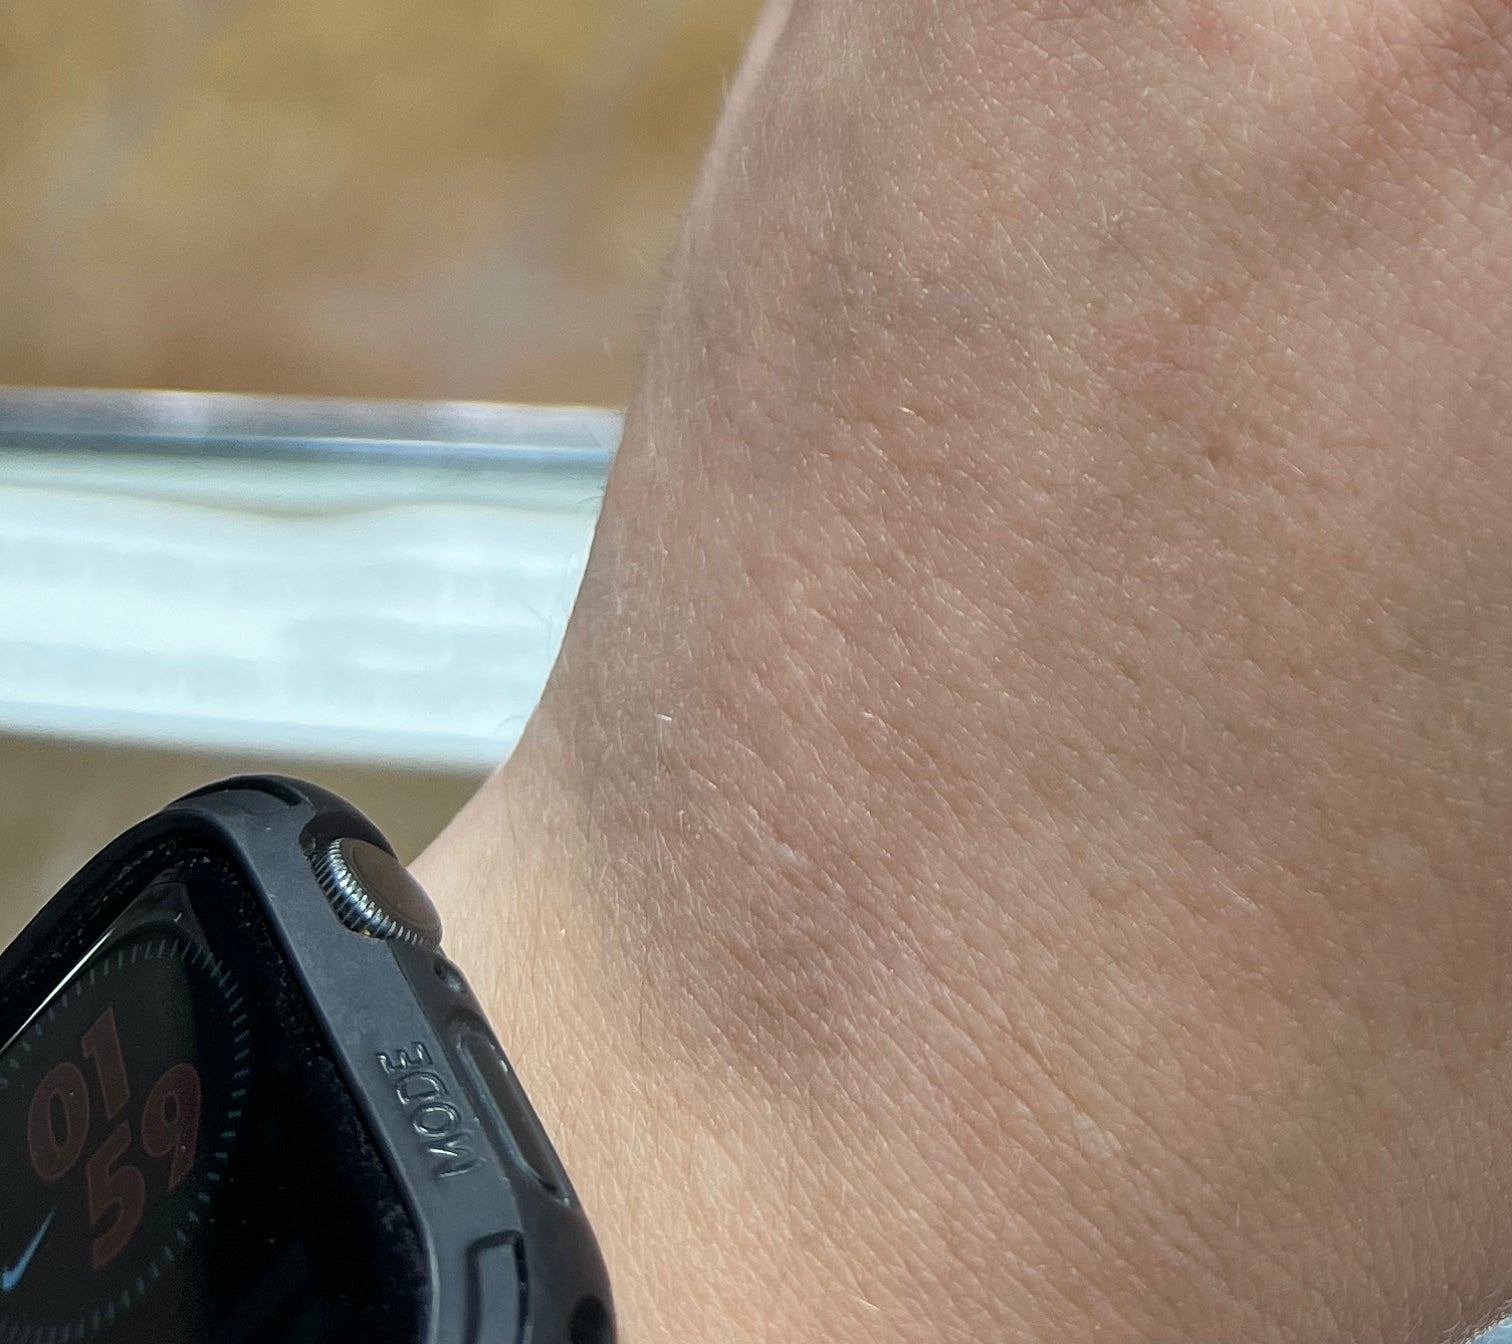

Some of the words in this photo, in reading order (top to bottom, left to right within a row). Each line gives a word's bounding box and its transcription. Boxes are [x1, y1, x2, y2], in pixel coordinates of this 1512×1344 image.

[27, 1007, 131, 1182] 01
[86, 1062, 201, 1270] 59
[376, 1041, 486, 1179] MODE
